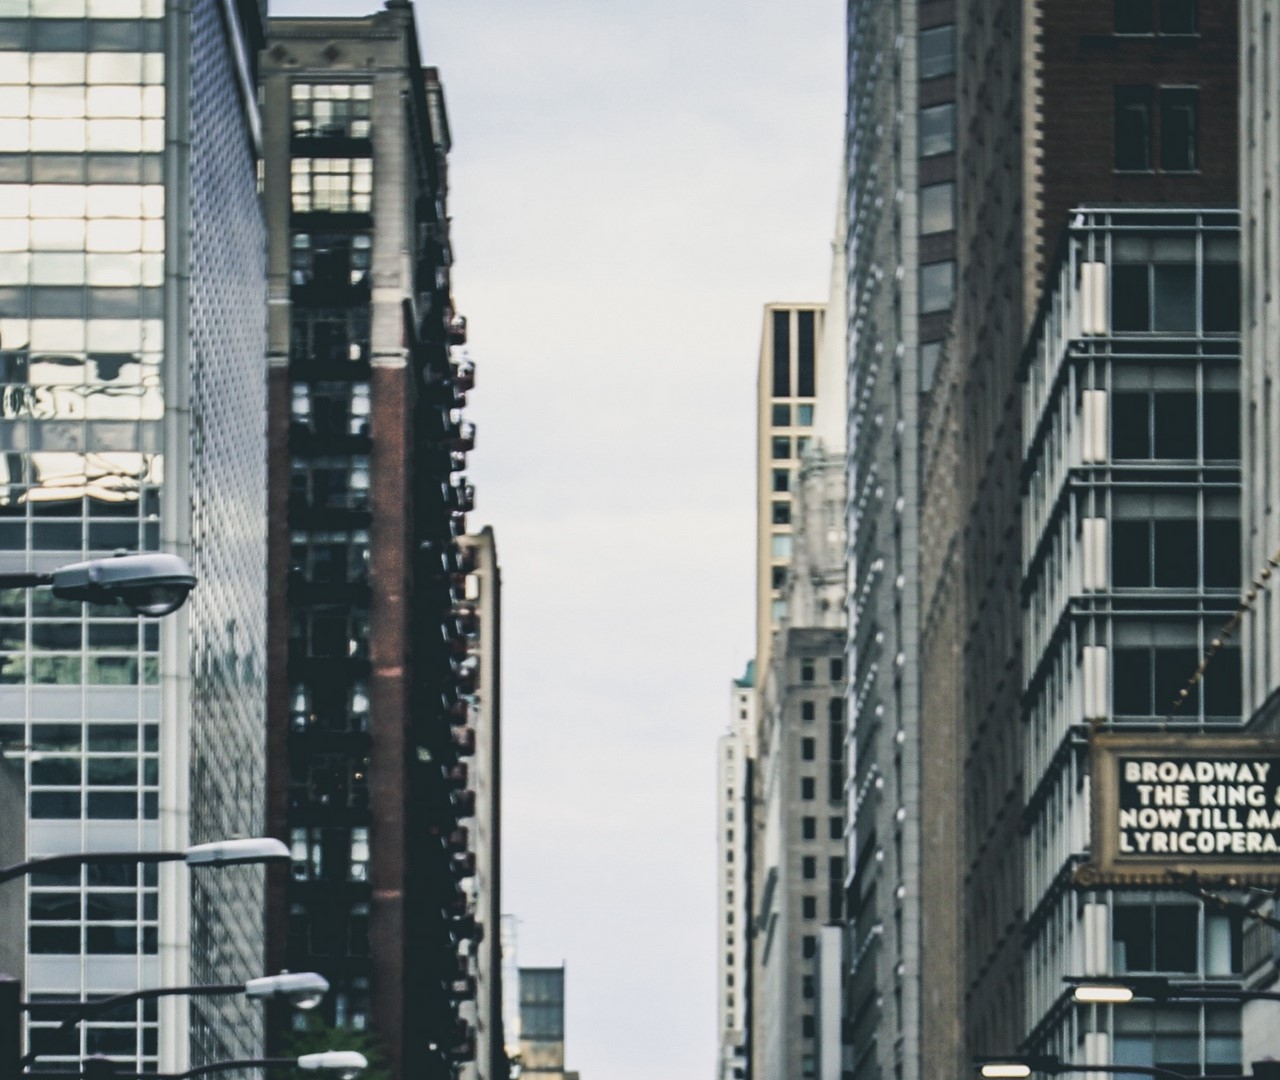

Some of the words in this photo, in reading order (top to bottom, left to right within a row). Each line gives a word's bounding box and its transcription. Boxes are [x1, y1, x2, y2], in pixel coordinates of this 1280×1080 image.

[1124, 761, 1271, 783] BROADWAY
[1136, 784, 1190, 806] THE
[1199, 784, 1267, 807] KING
[1119, 807, 1183, 830] NOW
[1184, 807, 1244, 830] TILL
